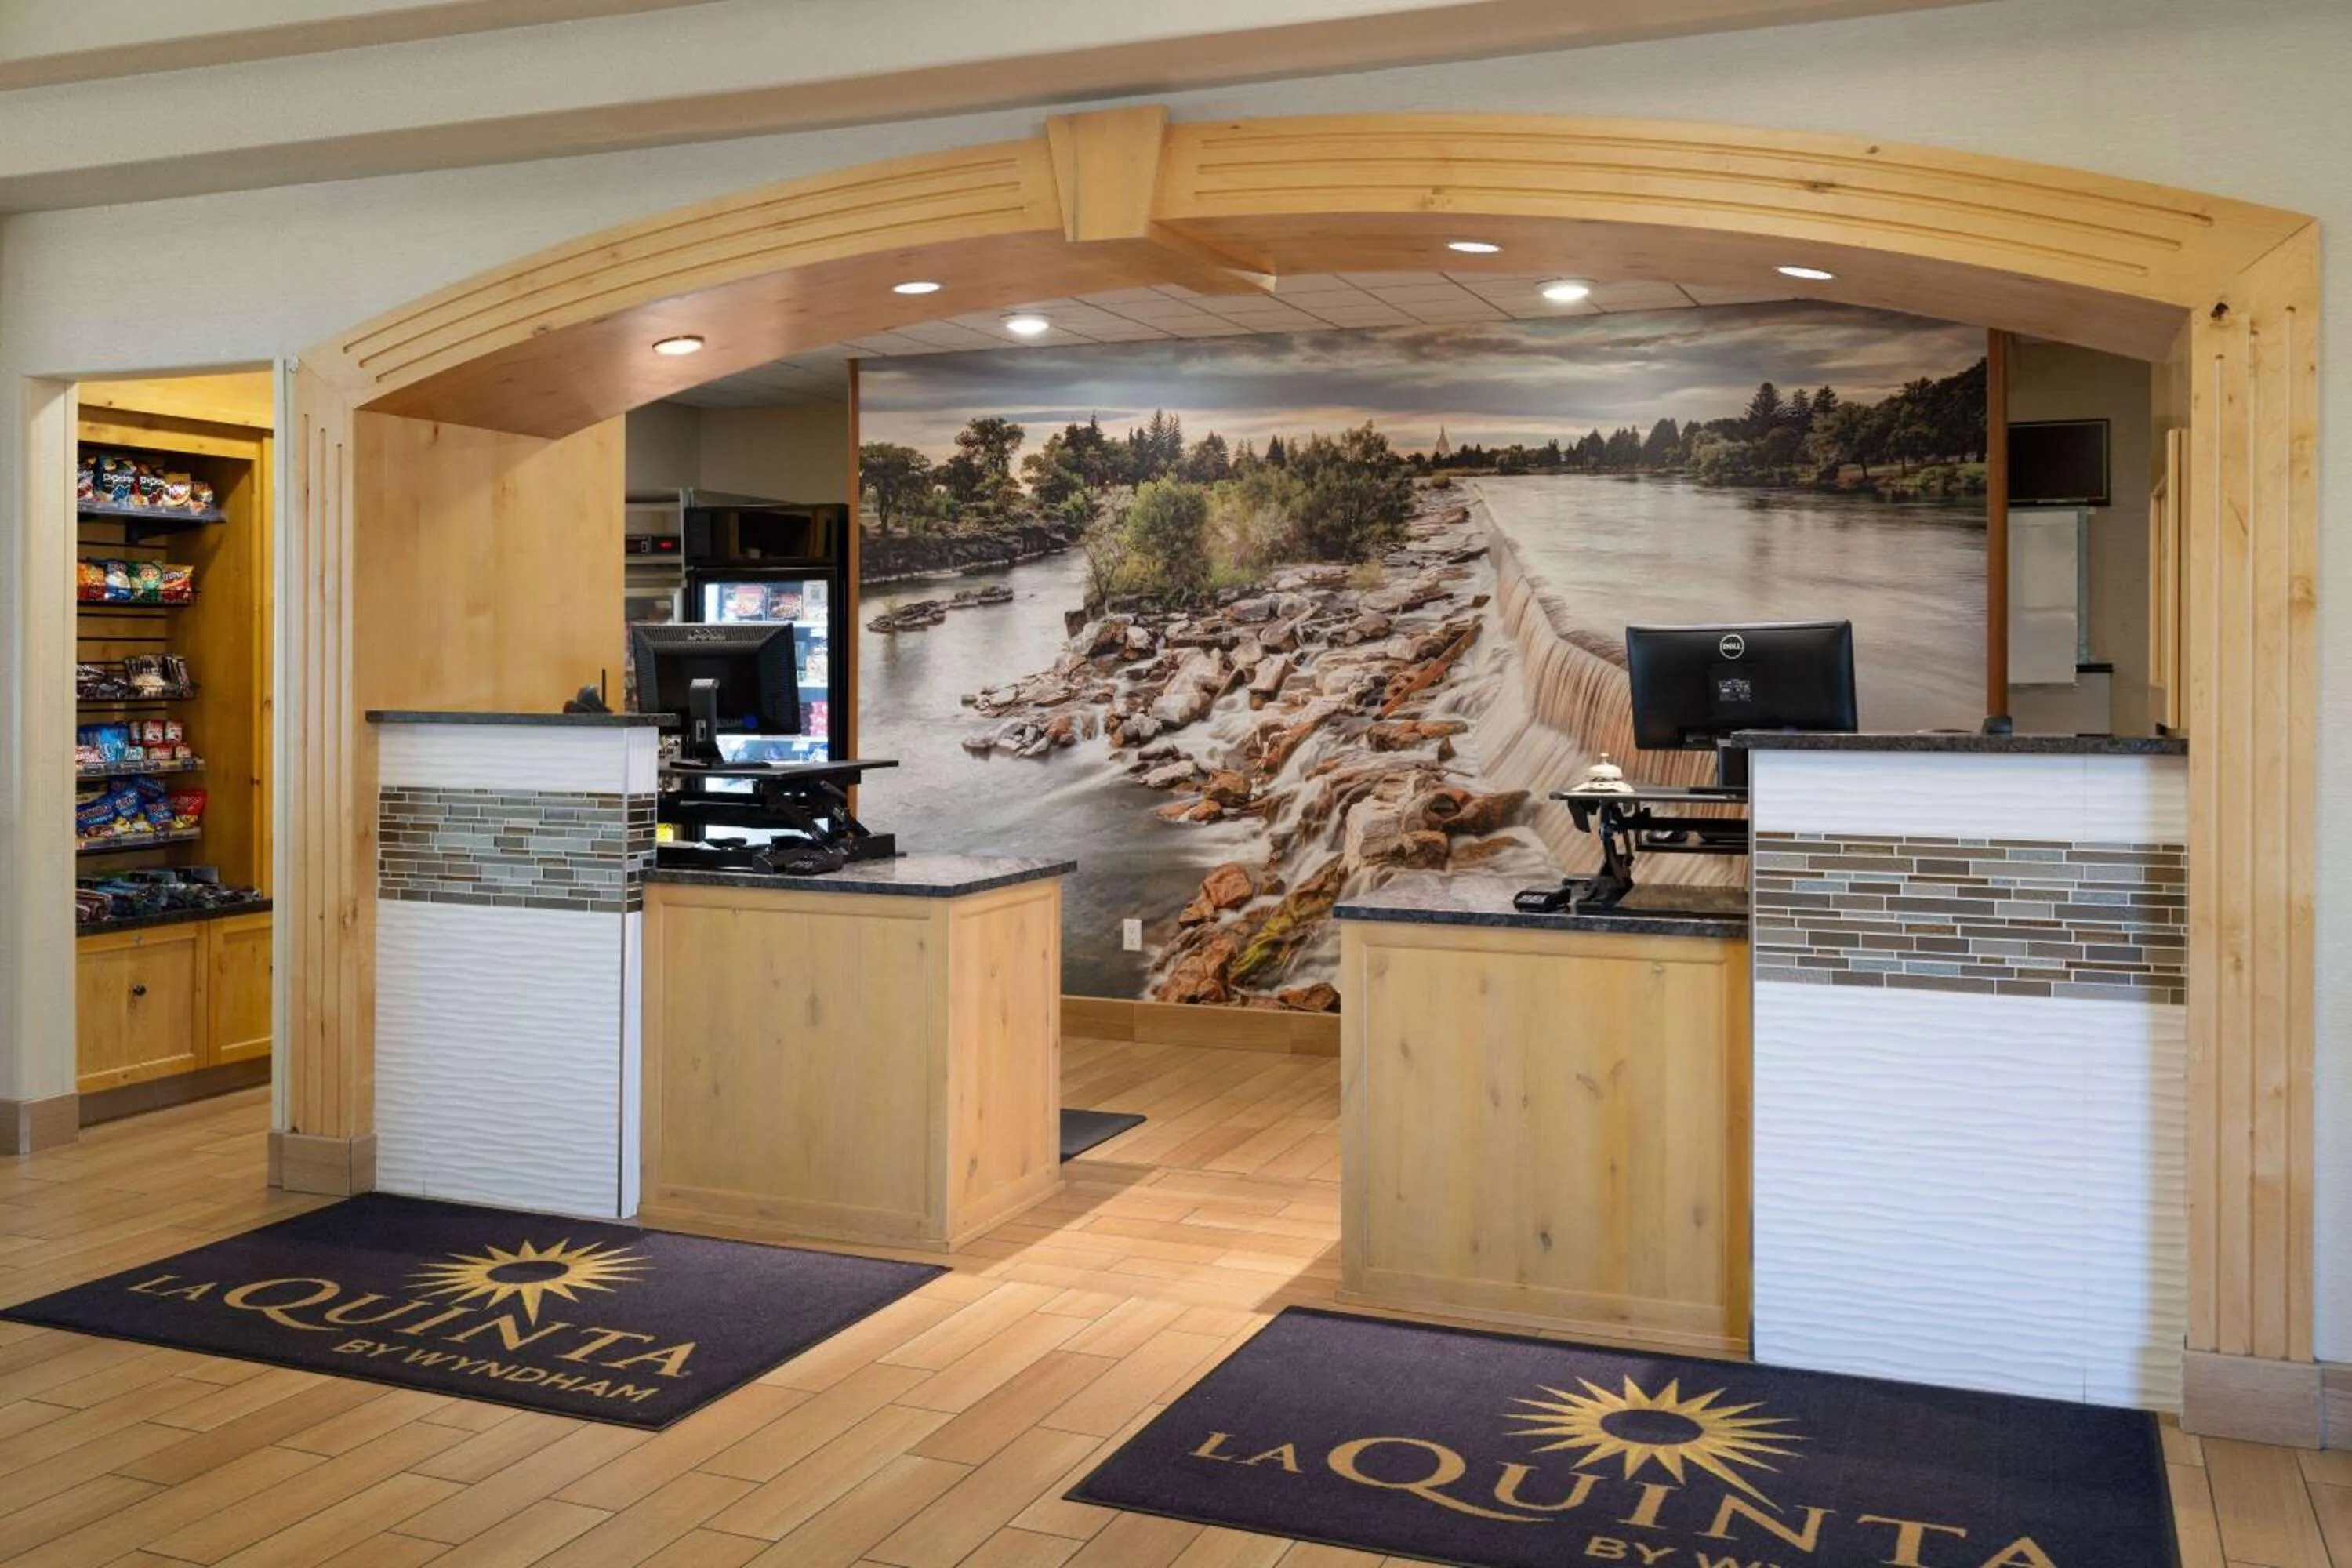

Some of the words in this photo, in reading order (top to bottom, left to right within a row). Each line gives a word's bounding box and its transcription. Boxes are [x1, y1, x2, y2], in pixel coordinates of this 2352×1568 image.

[128, 1274, 218, 1301] LA
[223, 1278, 697, 1377] QUINTA
[332, 1339, 408, 1357] BY
[402, 1349, 660, 1403] WYNDHAM
[1188, 1431, 1305, 1474] LA
[1584, 1535, 1678, 1565] BY
